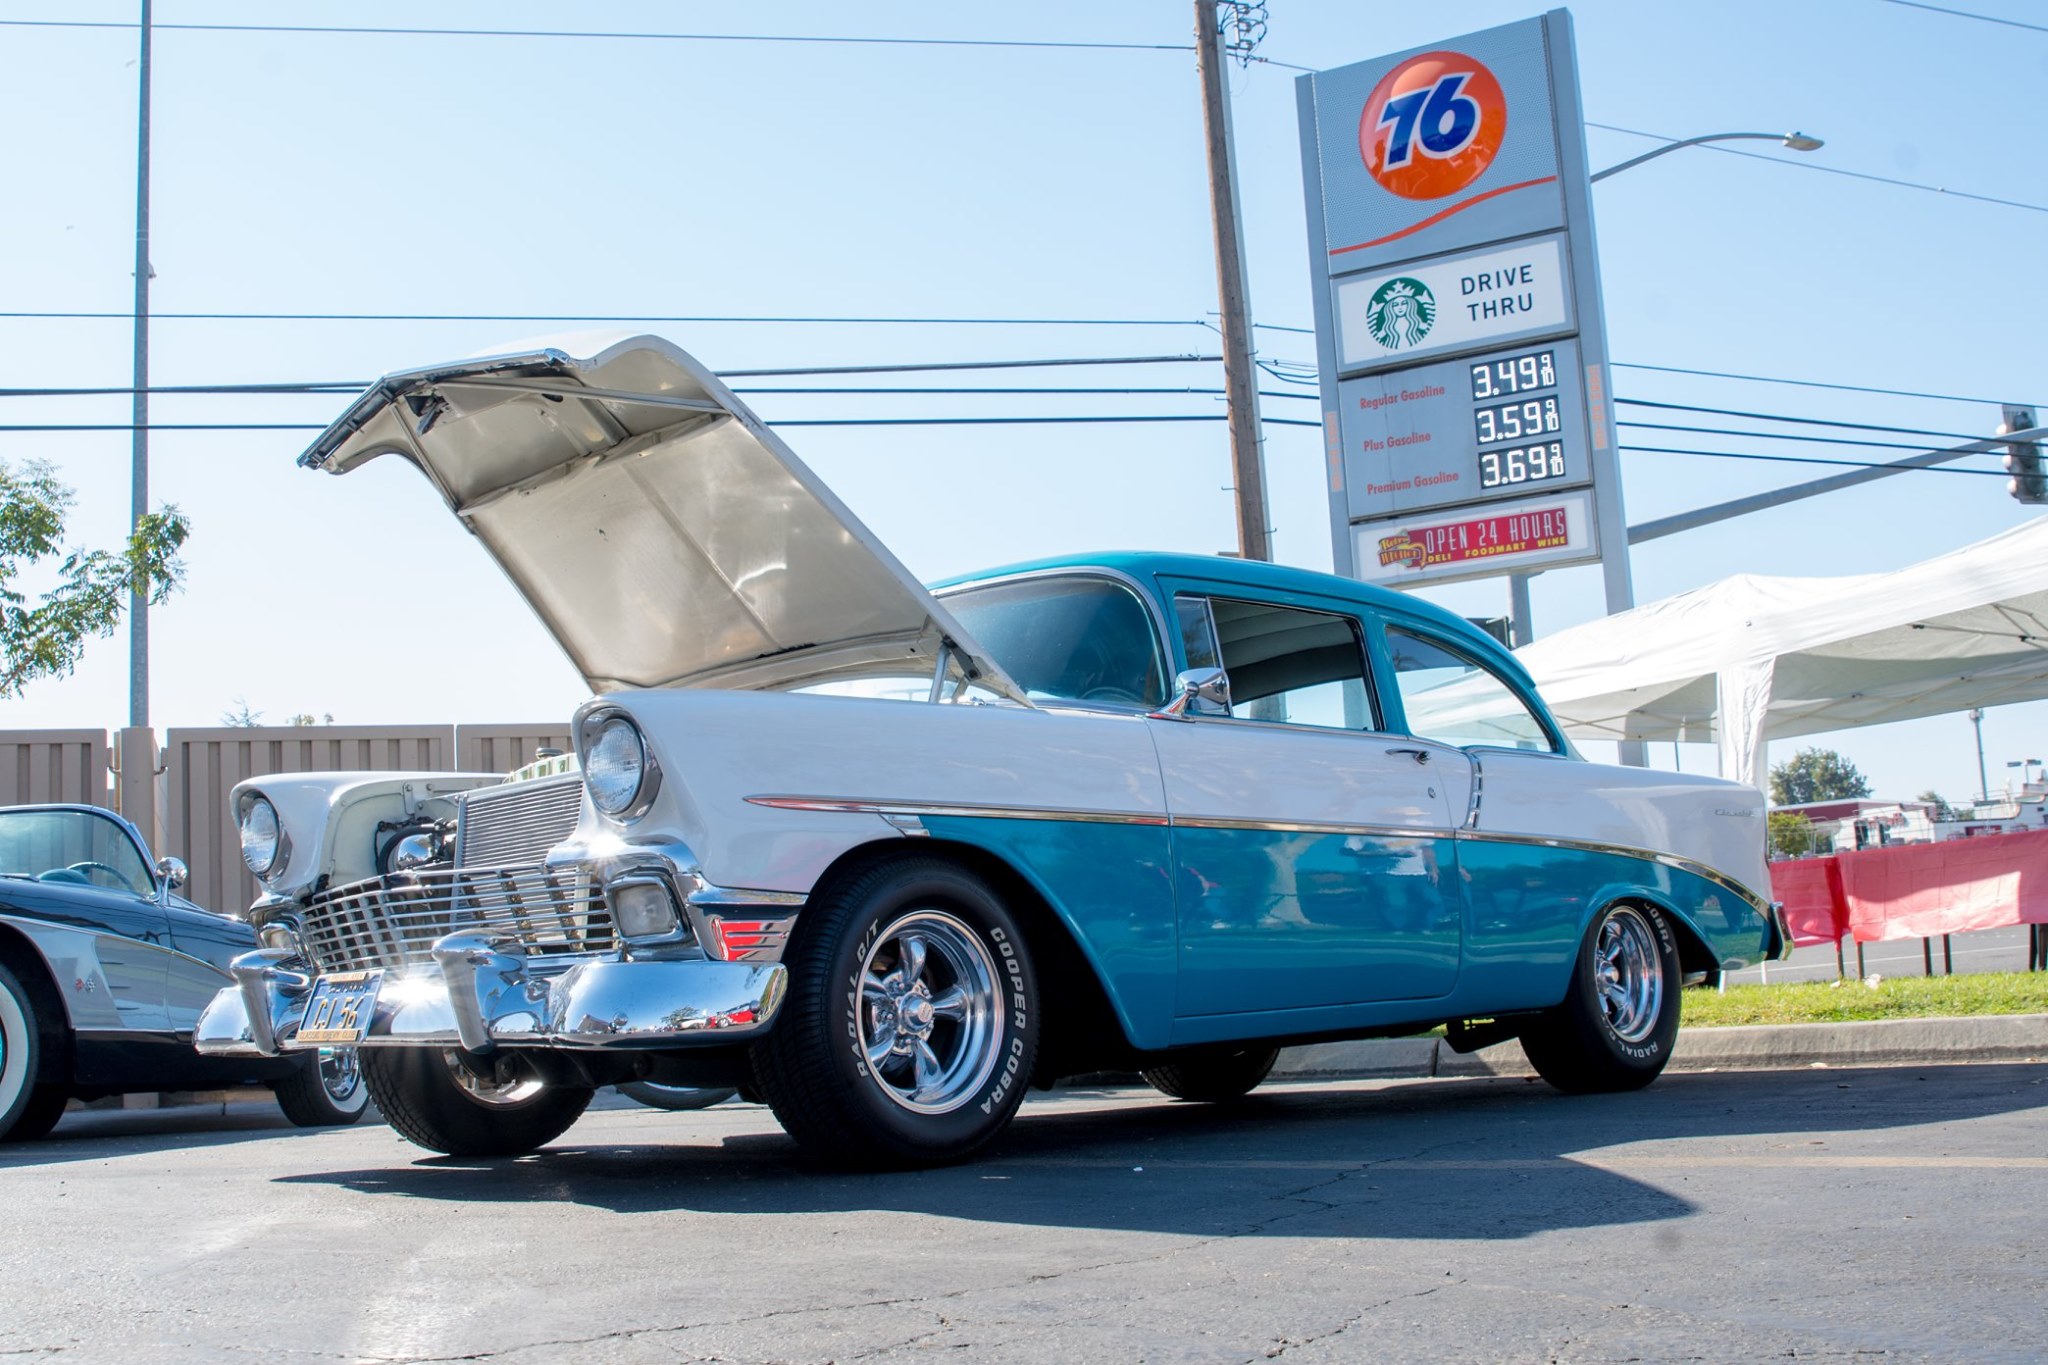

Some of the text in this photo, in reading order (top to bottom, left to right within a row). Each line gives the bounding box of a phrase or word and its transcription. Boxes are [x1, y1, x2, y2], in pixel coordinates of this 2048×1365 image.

[1375, 71, 1477, 172] 76
[1461, 264, 1533, 295] DRIVE
[1467, 293, 1533, 321] THRU
[1473, 357, 1538, 398] 3.49
[1360, 385, 1445, 410] Regular Gasoline
[1477, 401, 1542, 442] 3.59
[1364, 432, 1431, 452] Plus Gasoline
[1367, 471, 1459, 495] Premium Gasoline
[1482, 446, 1547, 487] 3.69
[1426, 525, 1468, 554] OPEN
[1478, 521, 1498, 546] 24
[1509, 511, 1565, 542] HOURS
[1428, 553, 1452, 563] DELI
[1465, 542, 1526, 558] FOODMART
[1537, 536, 1566, 548] WINE
[990, 927, 1026, 1029] COOPER
[337, 996, 364, 1029] 56
[848, 972, 868, 1078] RADIAL
[1618, 1041, 1659, 1058] RADIAL
[981, 1037, 1024, 1114] COBRA
